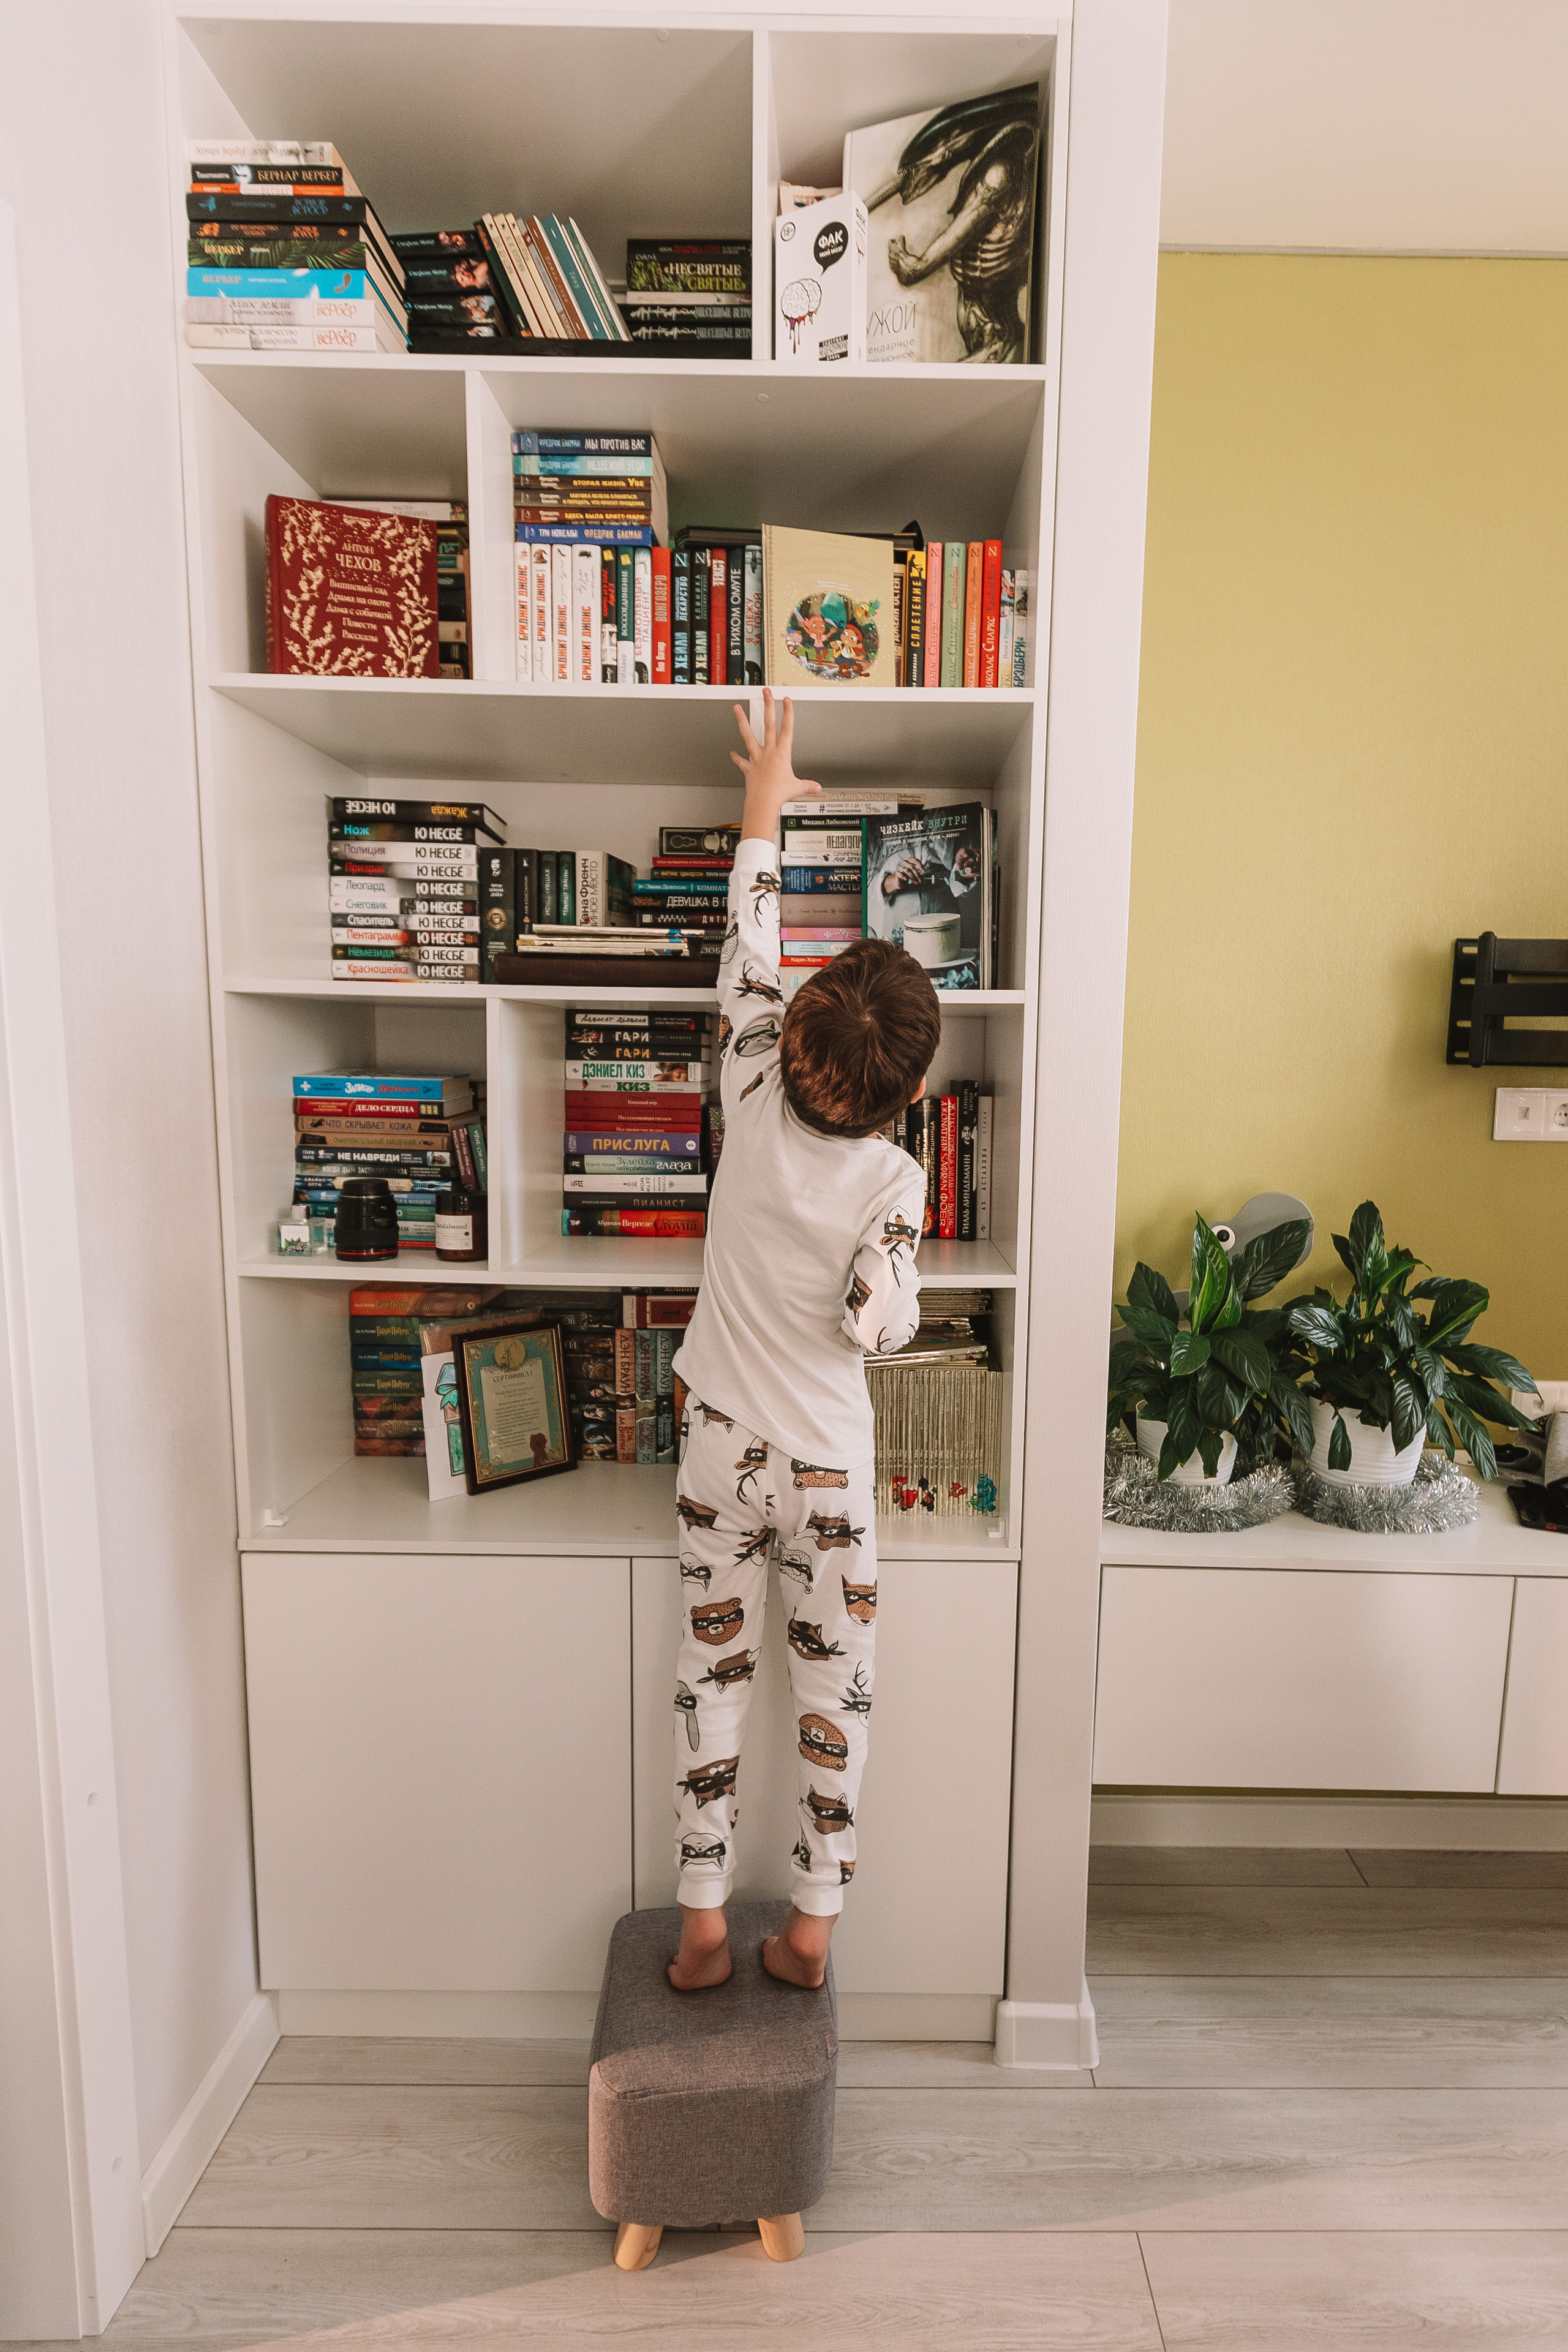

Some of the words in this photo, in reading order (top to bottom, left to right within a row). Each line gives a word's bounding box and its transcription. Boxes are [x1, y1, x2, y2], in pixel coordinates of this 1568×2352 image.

[257, 170, 299, 182] БЕРНАР
[818, 229, 843, 249] ФАК
[866, 301, 916, 337] УЖОЙ
[539, 439, 561, 448] ФРЕДРИК
[562, 439, 580, 448] БАКМАН
[585, 438, 598, 450] МЫ
[600, 439, 630, 451] ПРОТИВ
[631, 439, 646, 451] ВАС
[538, 528, 550, 537] ТРИ
[551, 529, 579, 538] НОВЕЛЛЫ
[584, 529, 614, 540] ФРЕДРИК
[617, 530, 643, 540] БАКМАН
[342, 542, 375, 555] АНТОН
[334, 553, 382, 573] ЧЕХОВ
[329, 578, 373, 594] Вишневый
[518, 565, 528, 597] ДЖОНС
[536, 573, 545, 602] ДЖОНС
[731, 568, 742, 605] ОМУТЕ
[327, 590, 355, 604] Драма
[356, 595, 366, 605] на
[367, 597, 391, 608] охоте
[655, 575, 668, 622] ВОНГОЗЕРО
[679, 576, 688, 622] ЛЕКАРСТВО
[325, 603, 349, 615] Дама
[355, 608, 393, 621] собачкой
[518, 599, 529, 641] БРИДЖИТ
[557, 604, 567, 636] ДЖОНС
[745, 597, 754, 634] СЛЕЖУ
[911, 580, 922, 647] СПЛЕТЕНИЕ
[342, 617, 378, 631] Повести
[537, 605, 546, 642] БРИДЖИТ
[581, 606, 592, 638] ДЖОНС
[731, 607, 742, 647] ТИХОМ
[342, 629, 379, 643] Рассказы
[754, 633, 761, 646] ЗА
[982, 616, 995, 652] СПАРКС
[674, 631, 688, 669] ХЕЙЛИ
[695, 630, 708, 669] ХЕЙЛИ
[557, 639, 567, 680] БРИДЖИТ
[582, 640, 592, 681] БРИДЖИТ
[1014, 640, 1025, 687] БРЭДБЕРИ
[985, 654, 994, 687] ИКОЛАС
[382, 802, 396, 815] Ю
[431, 805, 468, 818] Жажда
[344, 824, 371, 835] Нож
[415, 827, 428, 840] Ю
[429, 827, 463, 841] НЕСБЁ
[880, 819, 924, 835] ЧИЗКЕЙК
[927, 815, 968, 829] ВНУТРИ
[344, 843, 385, 855] Полиция
[415, 846, 427, 858] Ю
[429, 846, 462, 859] НЕСБЁ
[417, 865, 428, 876] Ю
[431, 864, 464, 877] НЕСБЁ
[579, 858, 590, 898] Френч
[589, 861, 598, 895] место
[345, 880, 385, 892] Леопард
[415, 882, 428, 894] Ю
[429, 882, 464, 896] НЕСБЁ
[345, 899, 387, 910] Снеговик
[415, 900, 428, 913] Ю
[430, 900, 464, 914] НЕСБЁ
[666, 896, 709, 908] ДЕВУШКА
[712, 897, 719, 907] В
[347, 914, 395, 926] Спаситель
[419, 917, 429, 927] Ю
[432, 917, 464, 929] НЕСБЁ
[580, 899, 589, 926] Тана
[702, 915, 727, 924] ДИТЯ
[347, 929, 409, 942] Пентаграмма
[417, 932, 428, 944] Ю
[431, 932, 464, 945] НЕСБЁ
[348, 946, 394, 958] Немезида
[419, 949, 430, 960] Ю
[432, 948, 465, 961] НЕСБЁ
[347, 963, 409, 975] Красношейка
[417, 965, 429, 977] Ю
[431, 965, 464, 978] НЕСБЁ
[615, 1031, 649, 1042] ГАРИ
[616, 1048, 650, 1058] ГАРИ
[582, 1063, 622, 1078] ДЭНИЕЛ
[626, 1064, 645, 1079] КИЗ
[616, 1082, 650, 1092] КИЗ
[355, 1104, 379, 1113] ДЕЛО
[380, 1104, 415, 1114] СЕРДЦА
[326, 1120, 341, 1128] ЧТО
[345, 1120, 385, 1129] СКРЫВАЕТ
[389, 1121, 412, 1131] КОЖА
[897, 1124, 906, 1136] 101
[473, 1130, 483, 1157] ИСТ-ЭНДА
[592, 1138, 671, 1151] ПРИСЛУГА
[337, 1152, 352, 1161] НЕ
[353, 1152, 399, 1163] НАВРЕДИ
[616, 1157, 655, 1166] Зулейха
[656, 1161, 692, 1172] глаза
[633, 1199, 685, 1207] ПИАНИСТ
[981, 1200, 986, 1211] АХ
[962, 1208, 970, 1234] ТИЛЛЬ
[619, 1334, 630, 1360] ДЭН
[639, 1335, 650, 1360] ДЭН
[660, 1335, 670, 1360] ДЭН
[492, 1369, 533, 1382] СЕРТИФИКАТ
[620, 1361, 630, 1394] БРАУН
[640, 1362, 650, 1396] БРАУН
[660, 1362, 670, 1395] БРАУН
